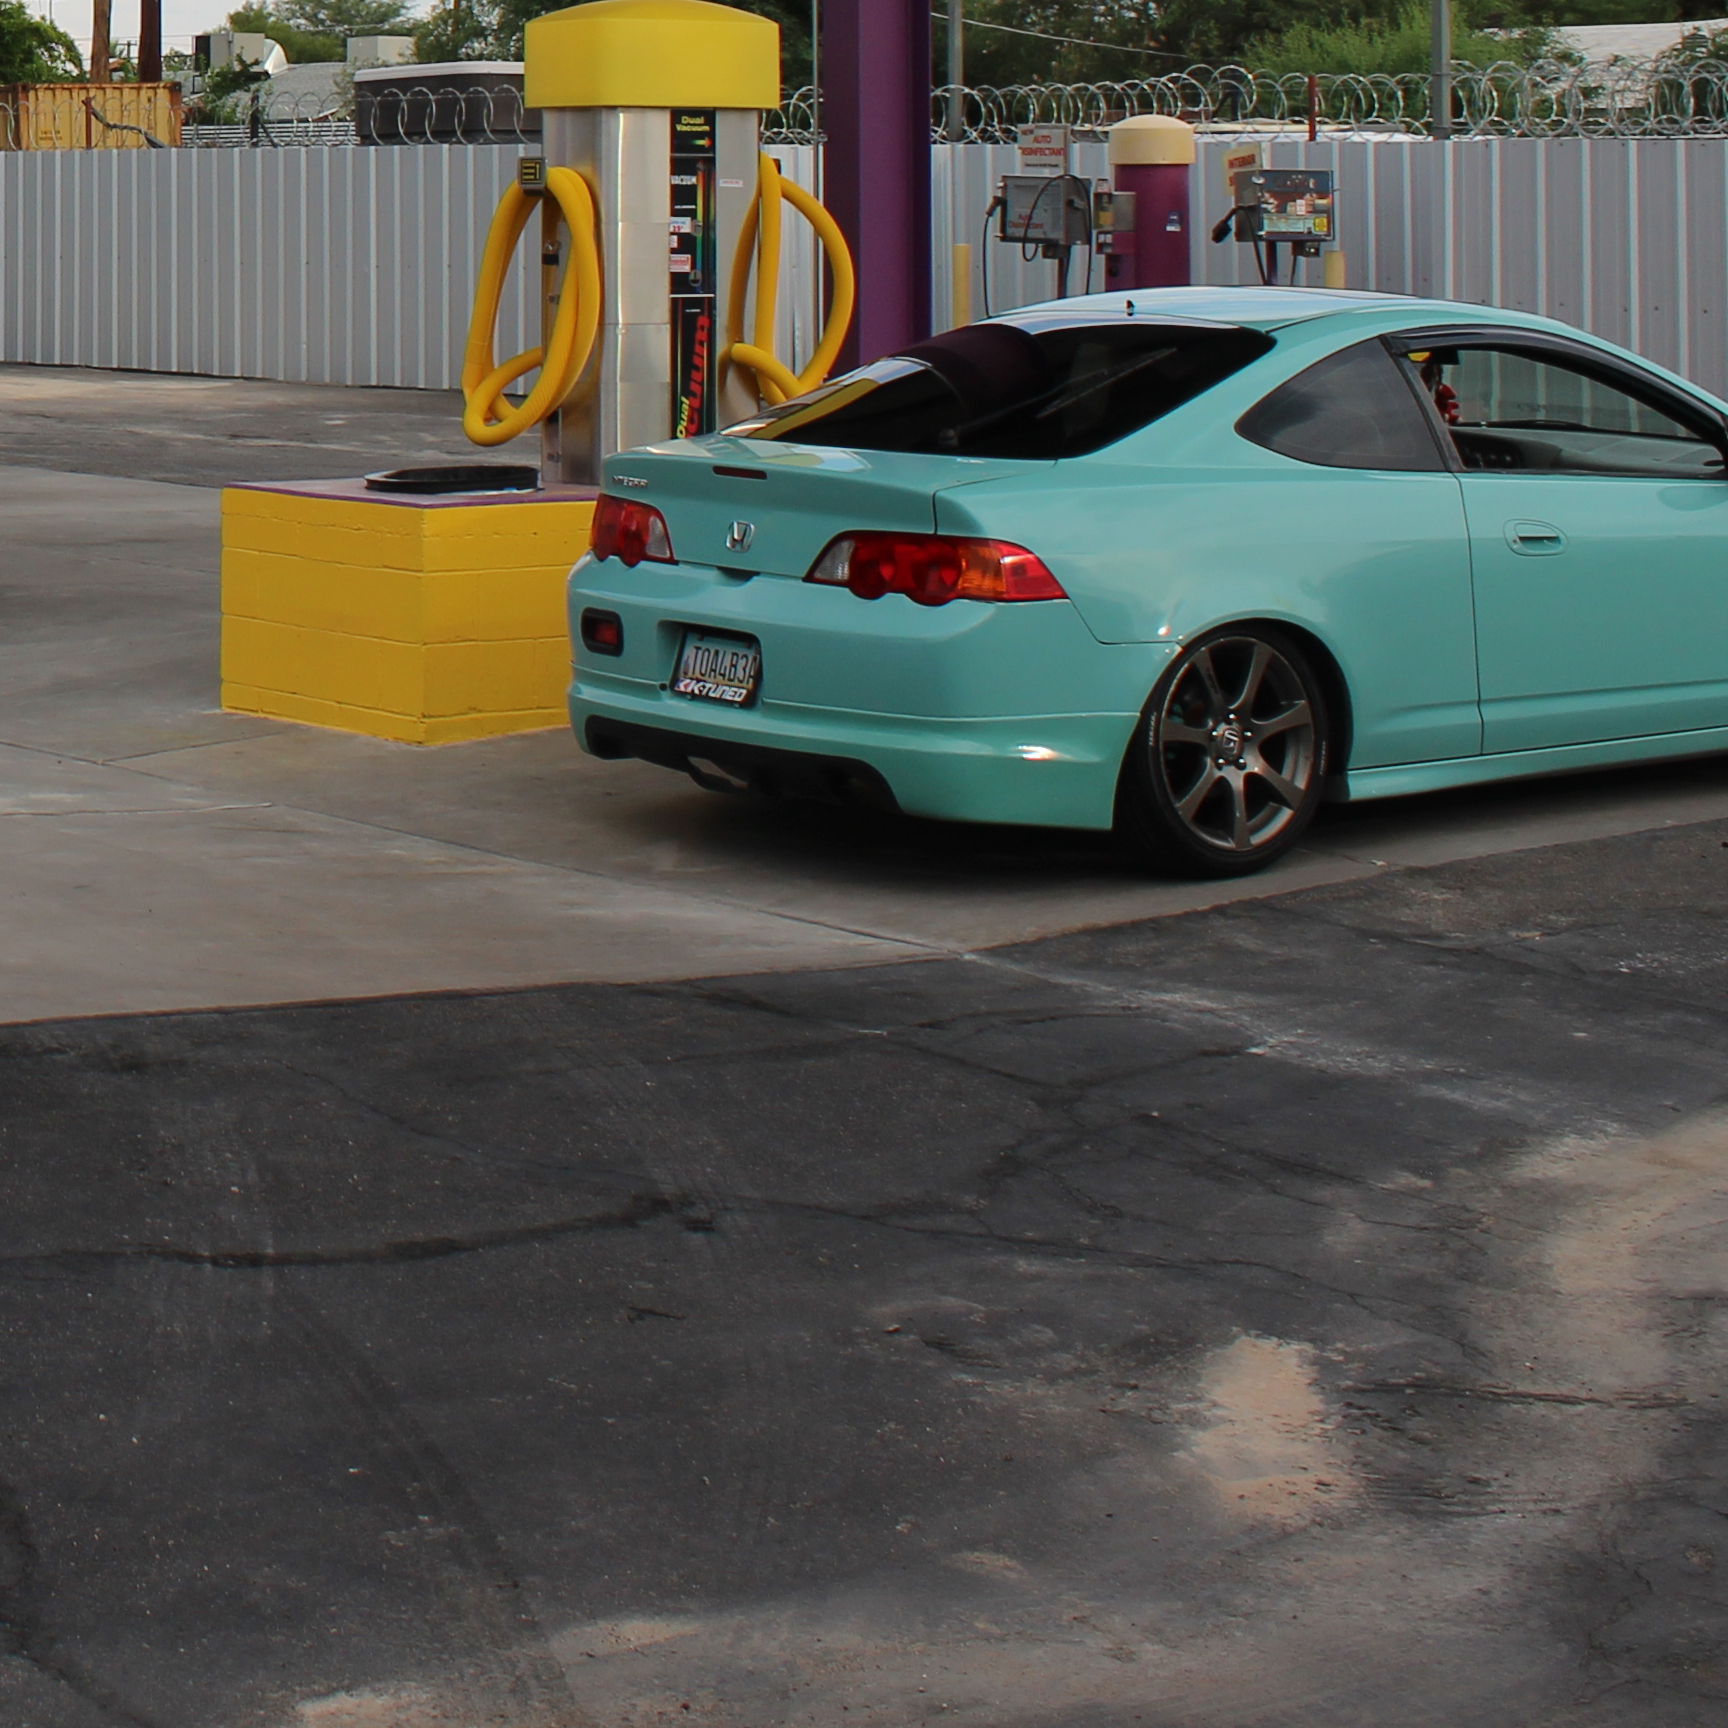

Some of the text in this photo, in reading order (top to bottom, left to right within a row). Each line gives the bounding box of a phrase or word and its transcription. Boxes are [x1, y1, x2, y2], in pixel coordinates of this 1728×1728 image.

[675, 124, 710, 132] Vacuum
[681, 116, 705, 124] Dual
[686, 314, 711, 438] cuum
[676, 395, 690, 439] Dual
